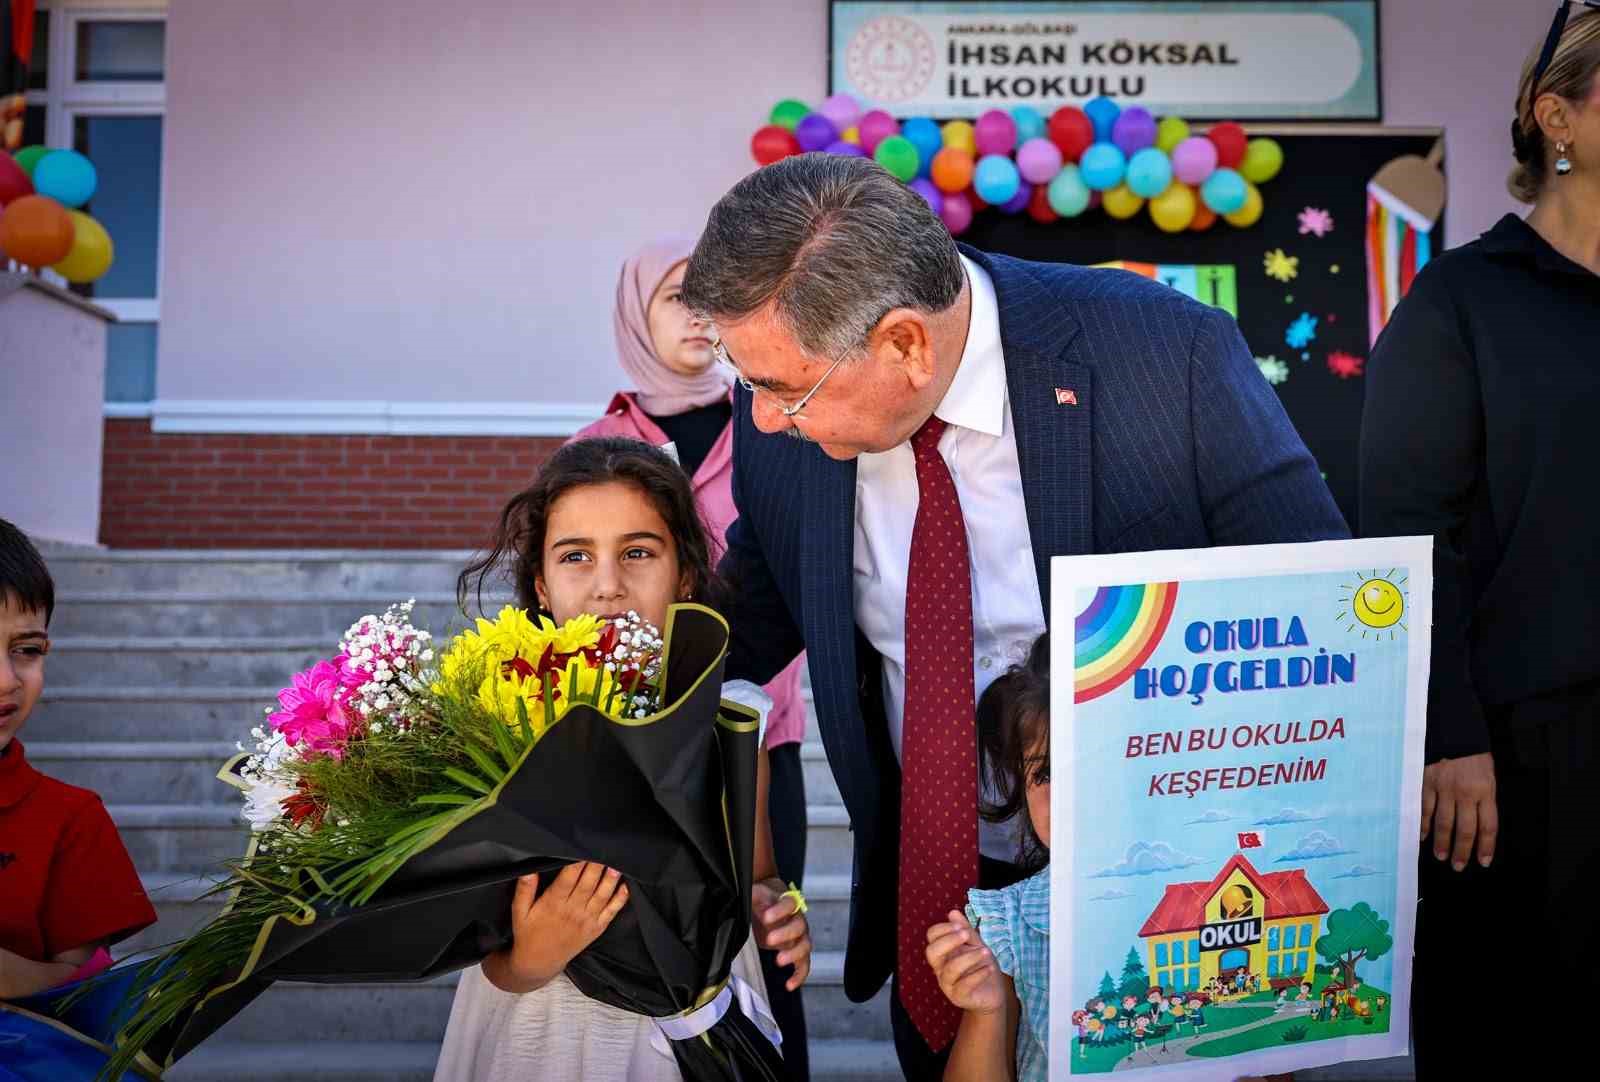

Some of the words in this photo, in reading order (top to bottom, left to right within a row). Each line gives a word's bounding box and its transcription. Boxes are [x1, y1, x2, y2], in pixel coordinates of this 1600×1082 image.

[947, 39, 1067, 66] İHSAN
[1082, 40, 1239, 66] KÖKSAL
[947, 74, 1146, 98] İLKOKULU
[1184, 615, 1309, 654] OKULA
[1133, 647, 1356, 706] HOŞGELDİN
[1125, 731, 1183, 759] BEN
[1187, 726, 1228, 752] BU
[1231, 717, 1346, 749] OKULDA
[1147, 756, 1328, 799] KEŞFEDENİM
[1200, 920, 1261, 948] OKUL
